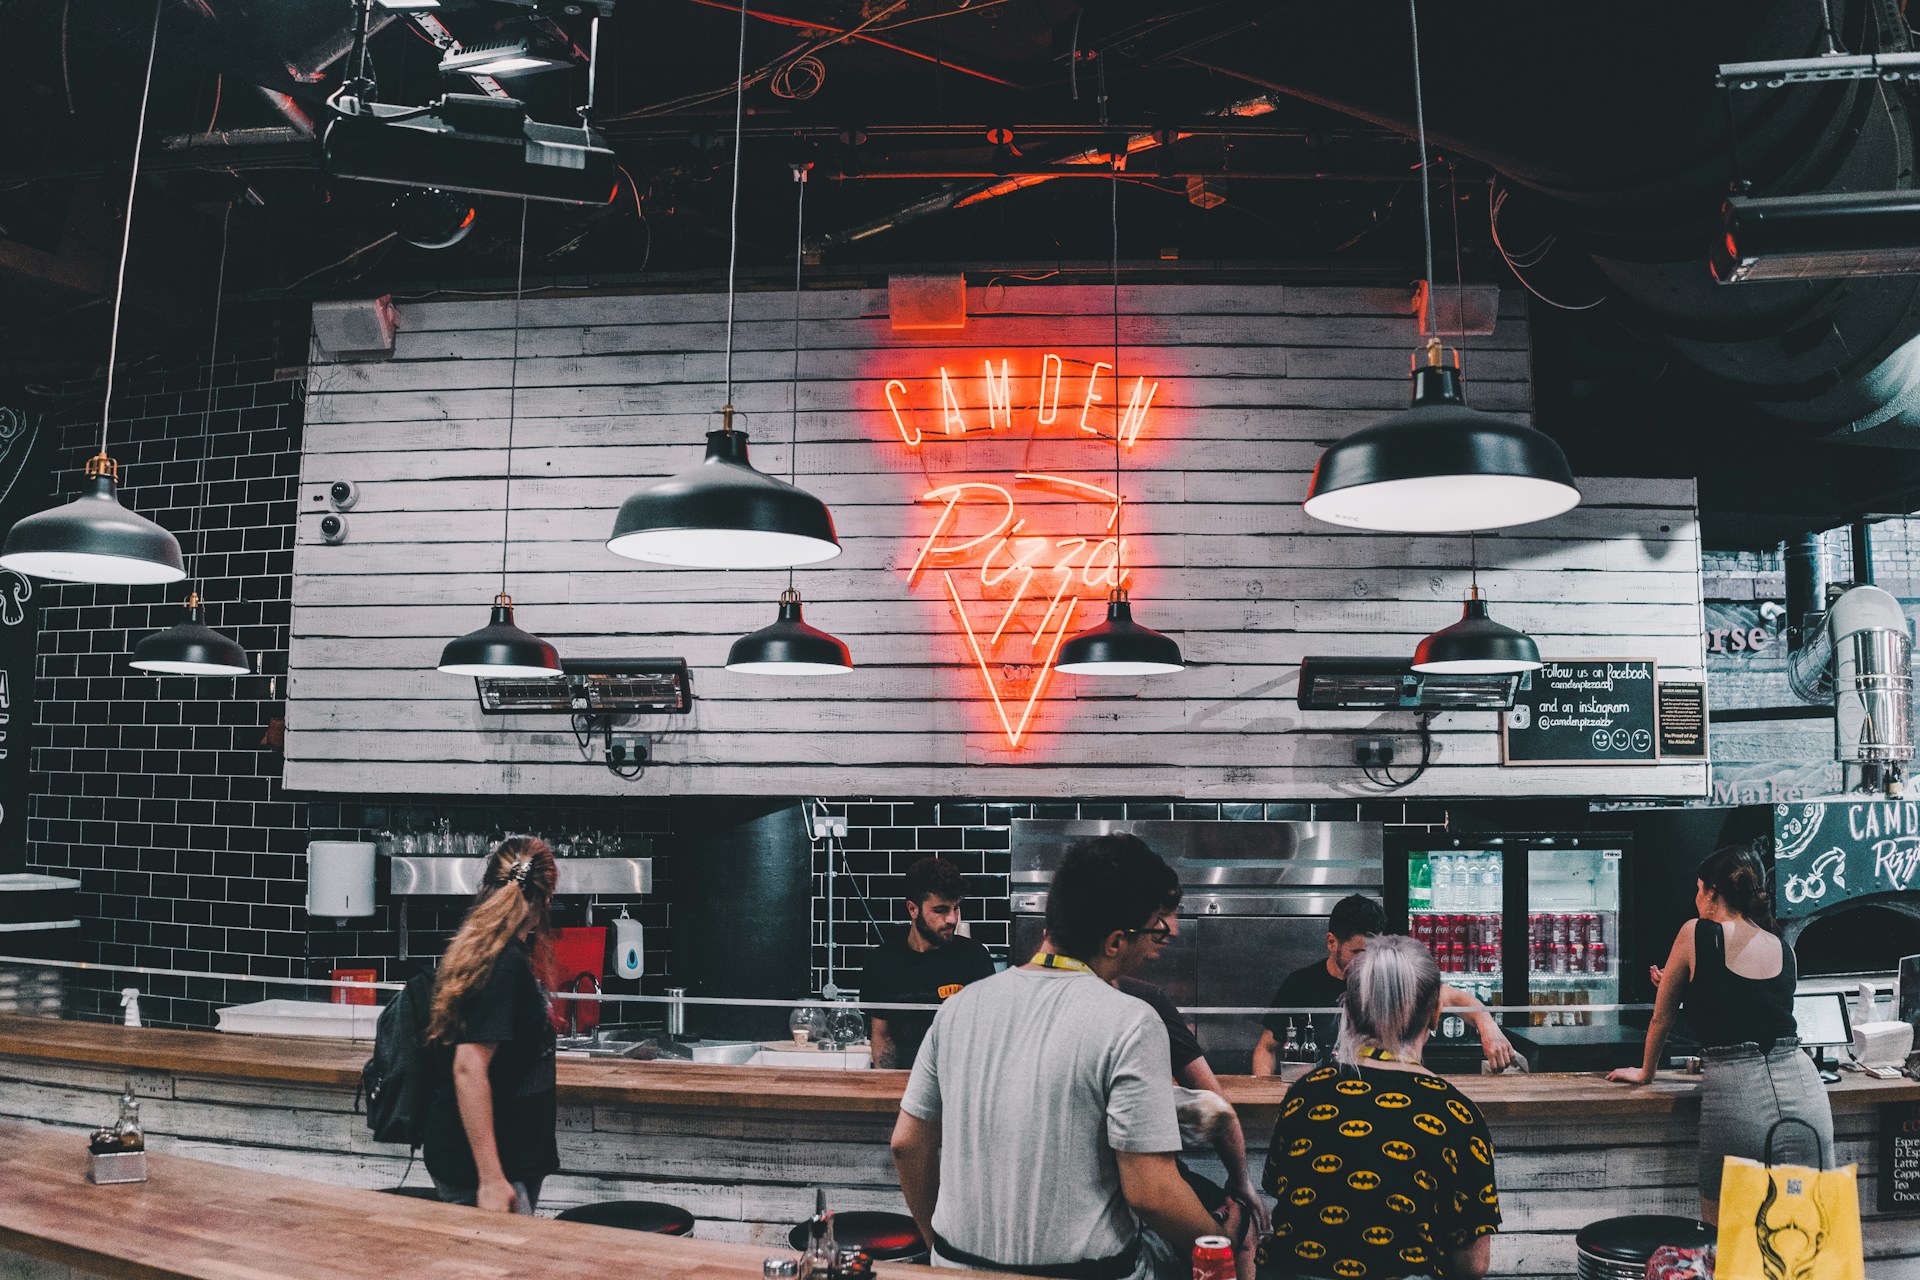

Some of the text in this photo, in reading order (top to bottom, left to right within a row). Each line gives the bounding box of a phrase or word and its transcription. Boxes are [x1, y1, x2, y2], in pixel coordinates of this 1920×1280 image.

[885, 353, 1159, 447] CAMDEN
[907, 482, 1131, 645] Pizza
[1703, 627, 1769, 651] rse
[1541, 662, 1651, 691] Follow us on facebook
[1539, 695, 1629, 720] and on instagram
[1712, 777, 1808, 805] Market
[1849, 801, 1919, 841] CAMD
[1894, 1158, 1918, 1168] Latte
[1894, 1180, 1909, 1190] Tea
